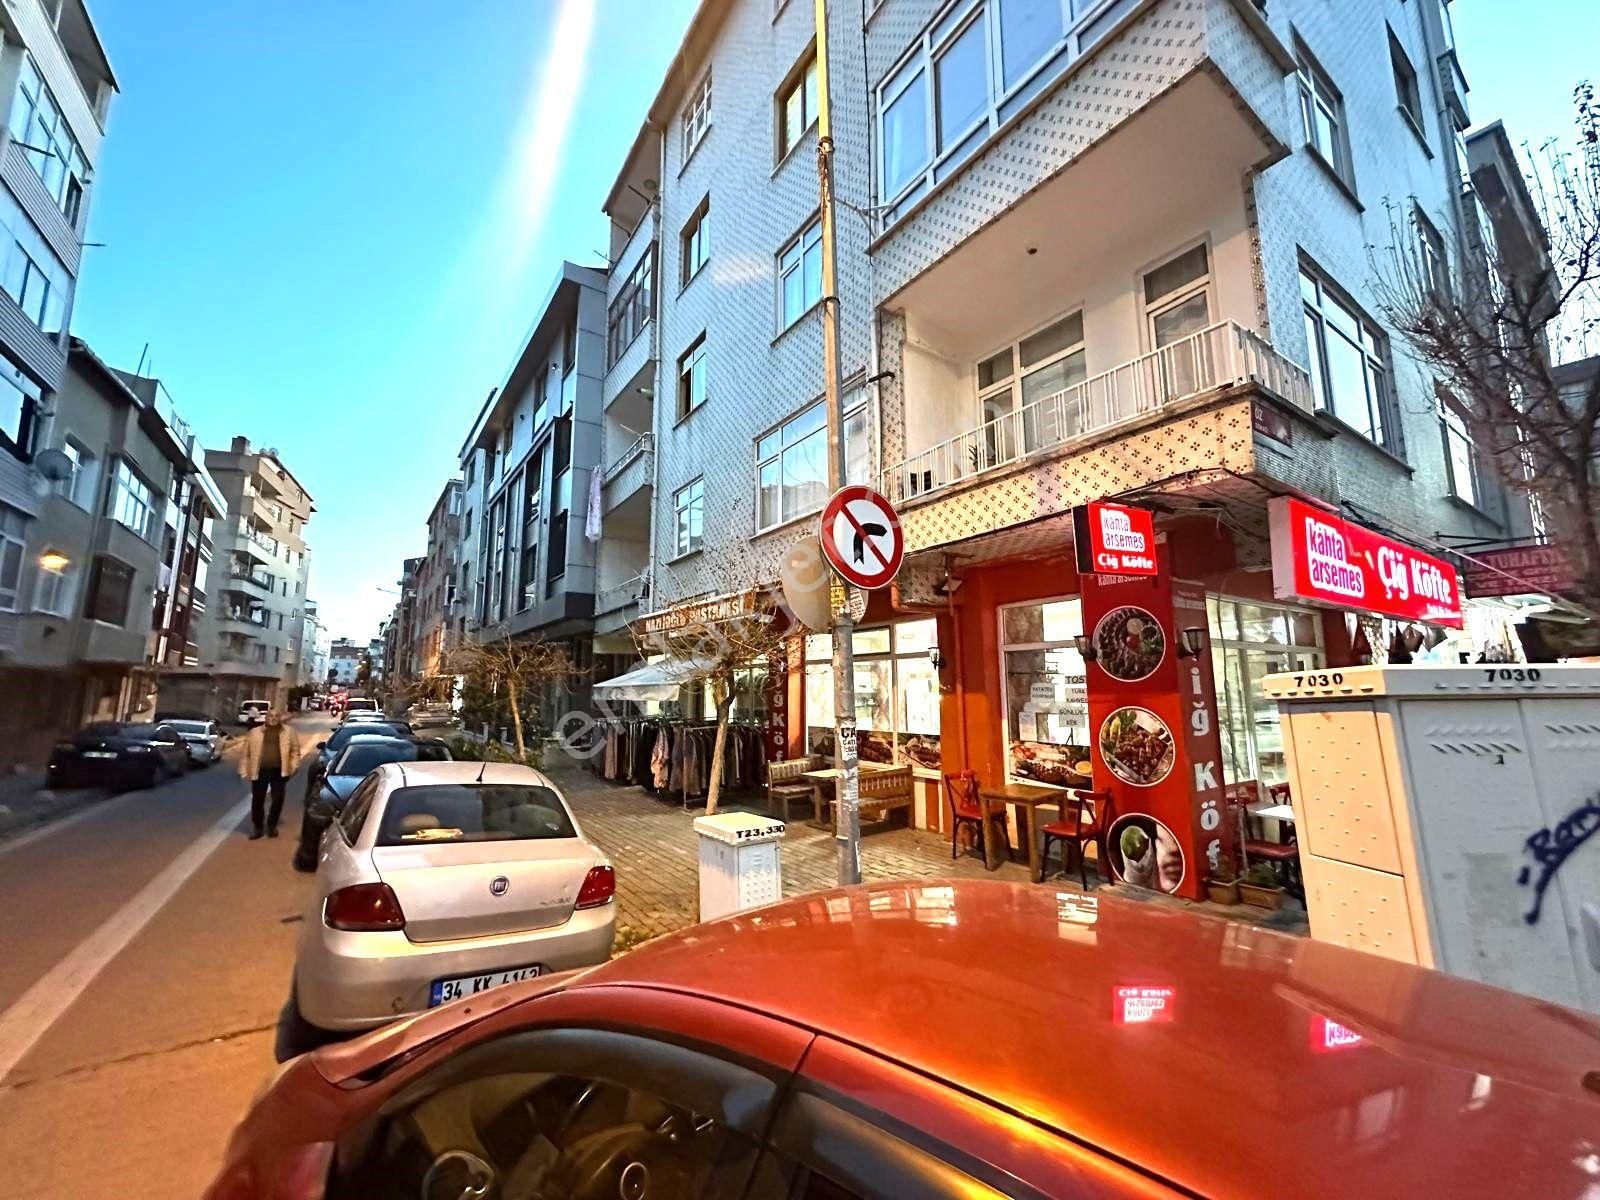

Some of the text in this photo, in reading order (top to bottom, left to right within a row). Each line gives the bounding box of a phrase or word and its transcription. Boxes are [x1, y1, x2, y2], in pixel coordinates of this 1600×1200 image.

[1105, 533, 1144, 549] arsemes
[1121, 555, 1154, 569] Köfte
[1312, 558, 1362, 593] arsemes
[1378, 546, 1452, 604] Çiğ Köfte
[1294, 672, 1344, 688] 7030
[1484, 668, 1541, 683] 7030
[443, 982, 462, 1001] 34
